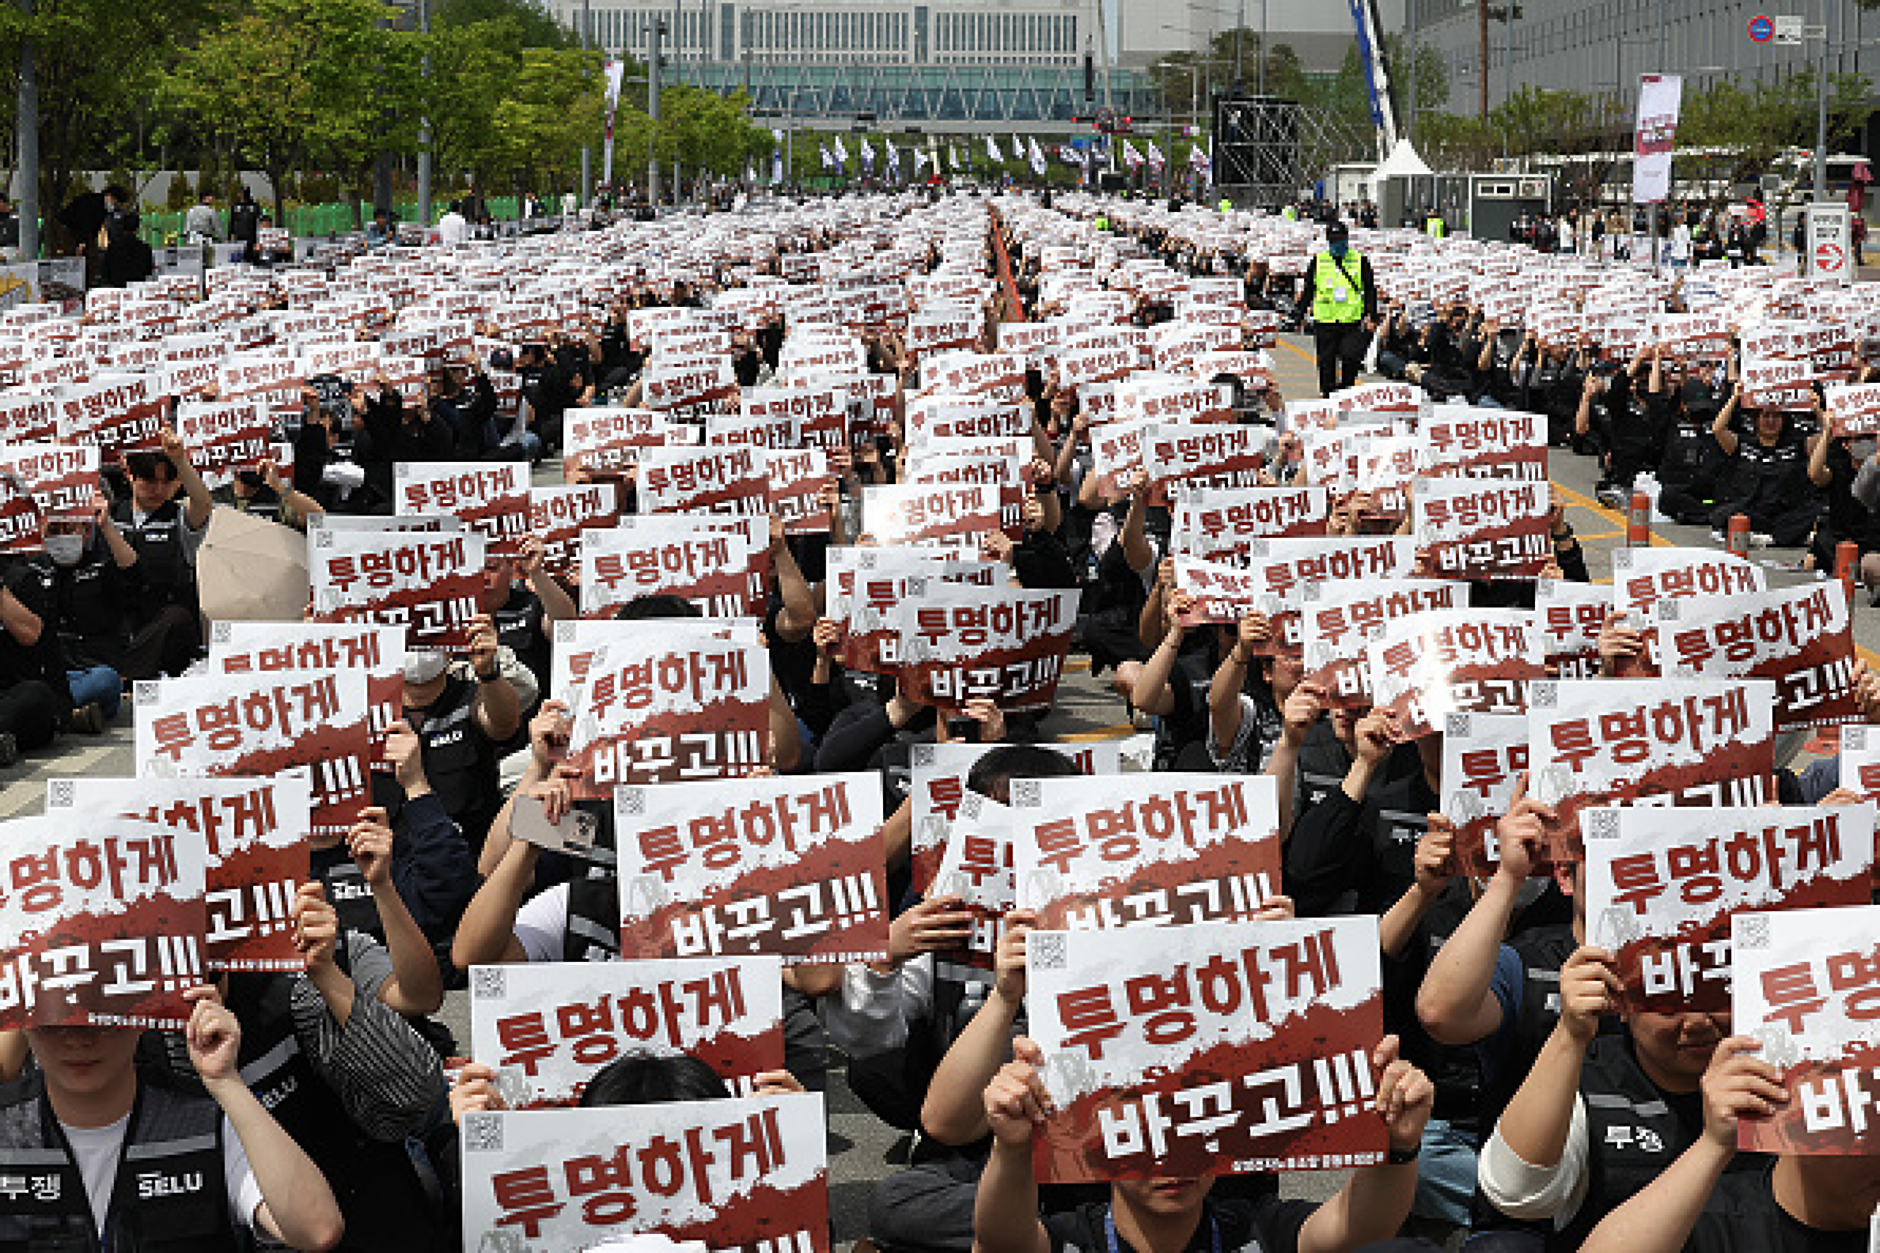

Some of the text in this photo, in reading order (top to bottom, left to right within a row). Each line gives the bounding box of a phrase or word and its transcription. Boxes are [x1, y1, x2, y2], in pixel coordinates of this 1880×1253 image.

[1155, 430, 1248, 466] 투명하게
[1430, 418, 1534, 452] 투명하게
[405, 465, 514, 512] 투명하게
[649, 449, 753, 497] 투명하게
[1424, 485, 1537, 529] 투명하게
[1199, 490, 1312, 539] 투명하게
[328, 537, 466, 592] 투명하게
[595, 538, 729, 589] 투명하게
[1264, 540, 1397, 598] 투명하게
[1439, 534, 1546, 572] 바꾸고!!!
[917, 595, 1062, 646] 투명하게
[1673, 587, 1834, 672] 투명하게
[152, 674, 340, 762] 투명하게
[589, 648, 747, 721] 투명하게
[594, 731, 760, 783] 바꾸고!!!
[1550, 686, 1750, 774] 투명하게
[638, 781, 852, 883] 투명하게
[1034, 780, 1250, 875] 투명하게
[1610, 813, 1841, 915] 투명하게
[0, 834, 178, 912] 명하게
[671, 872, 881, 957] 바꾸고!!!
[496, 965, 747, 1076] 투명하게
[1056, 928, 1343, 1061] 투명하게
[1760, 943, 1880, 1035] 투명
[1098, 1049, 1377, 1162] 바꾸고!!!
[137, 1171, 204, 1199] SELU
[491, 1107, 786, 1238] 투명하게
